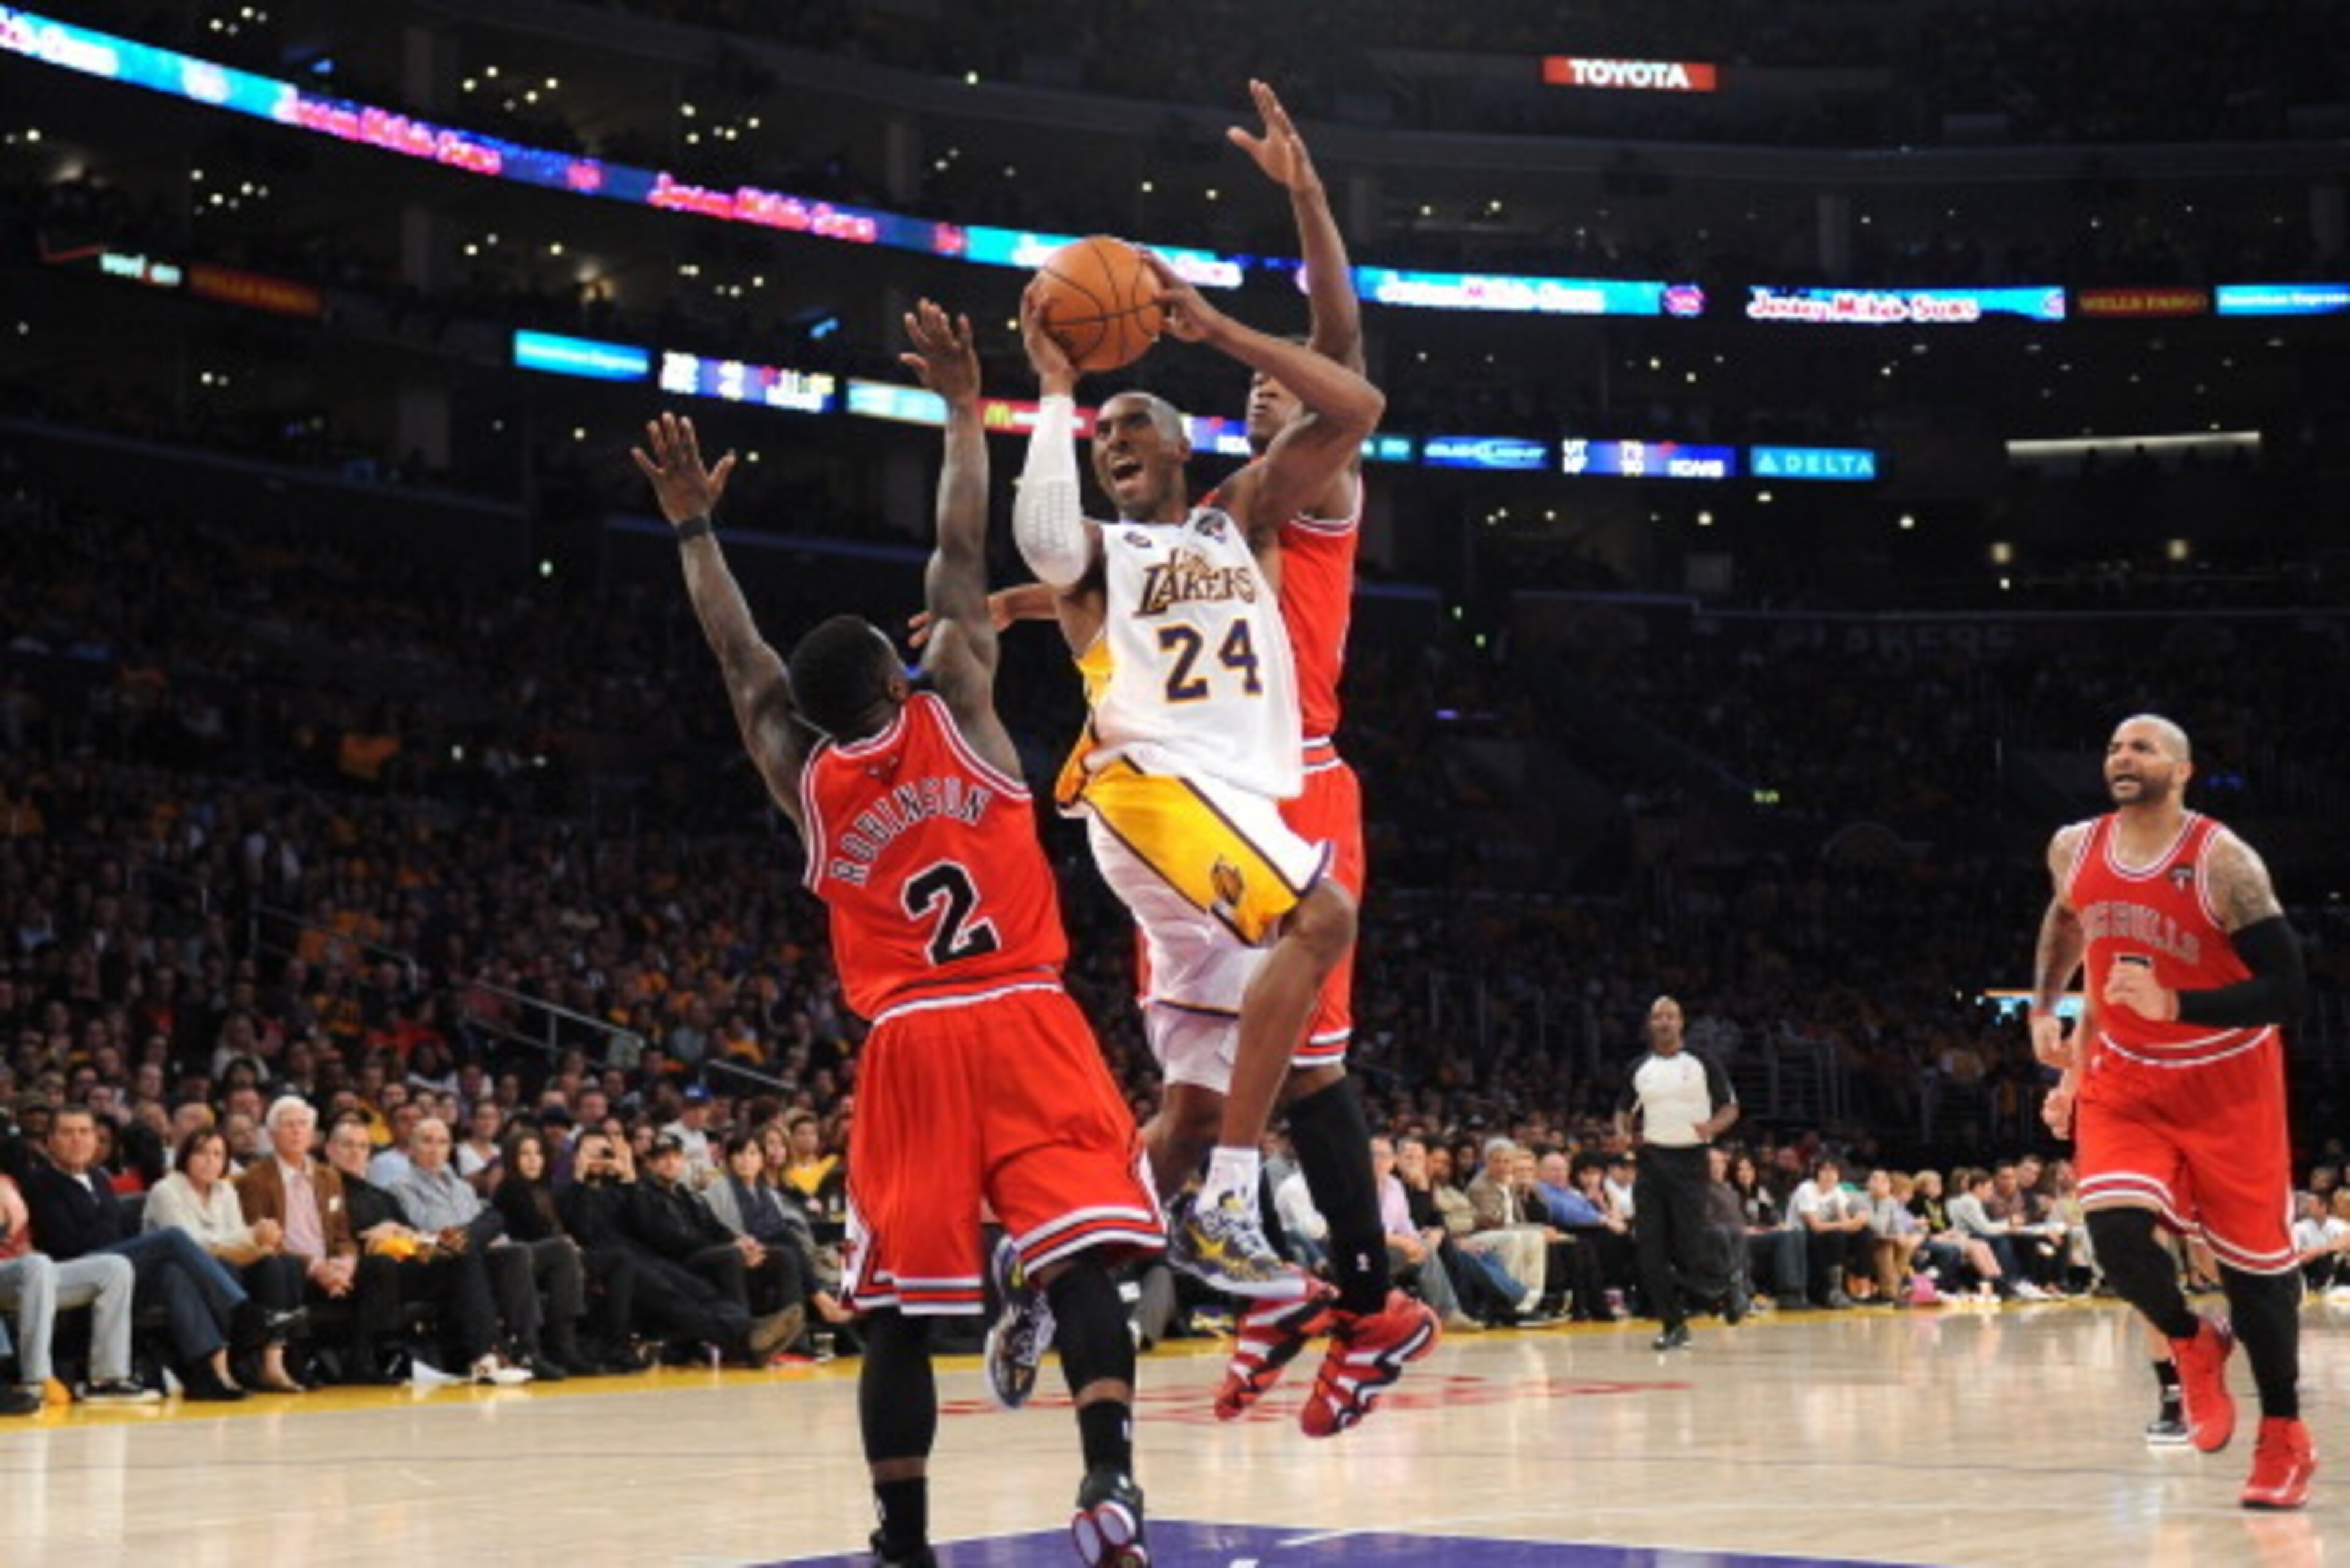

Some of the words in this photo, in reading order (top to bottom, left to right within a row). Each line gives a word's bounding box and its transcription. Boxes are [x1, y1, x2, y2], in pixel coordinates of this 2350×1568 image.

[1567, 58, 1692, 90] TOYOTA
[1785, 452, 1876, 475] DELTA
[1132, 561, 1258, 618] LAKERS
[1155, 614, 1263, 704] 24
[829, 775, 994, 889] ROBINSON
[900, 857, 1002, 967] 2
